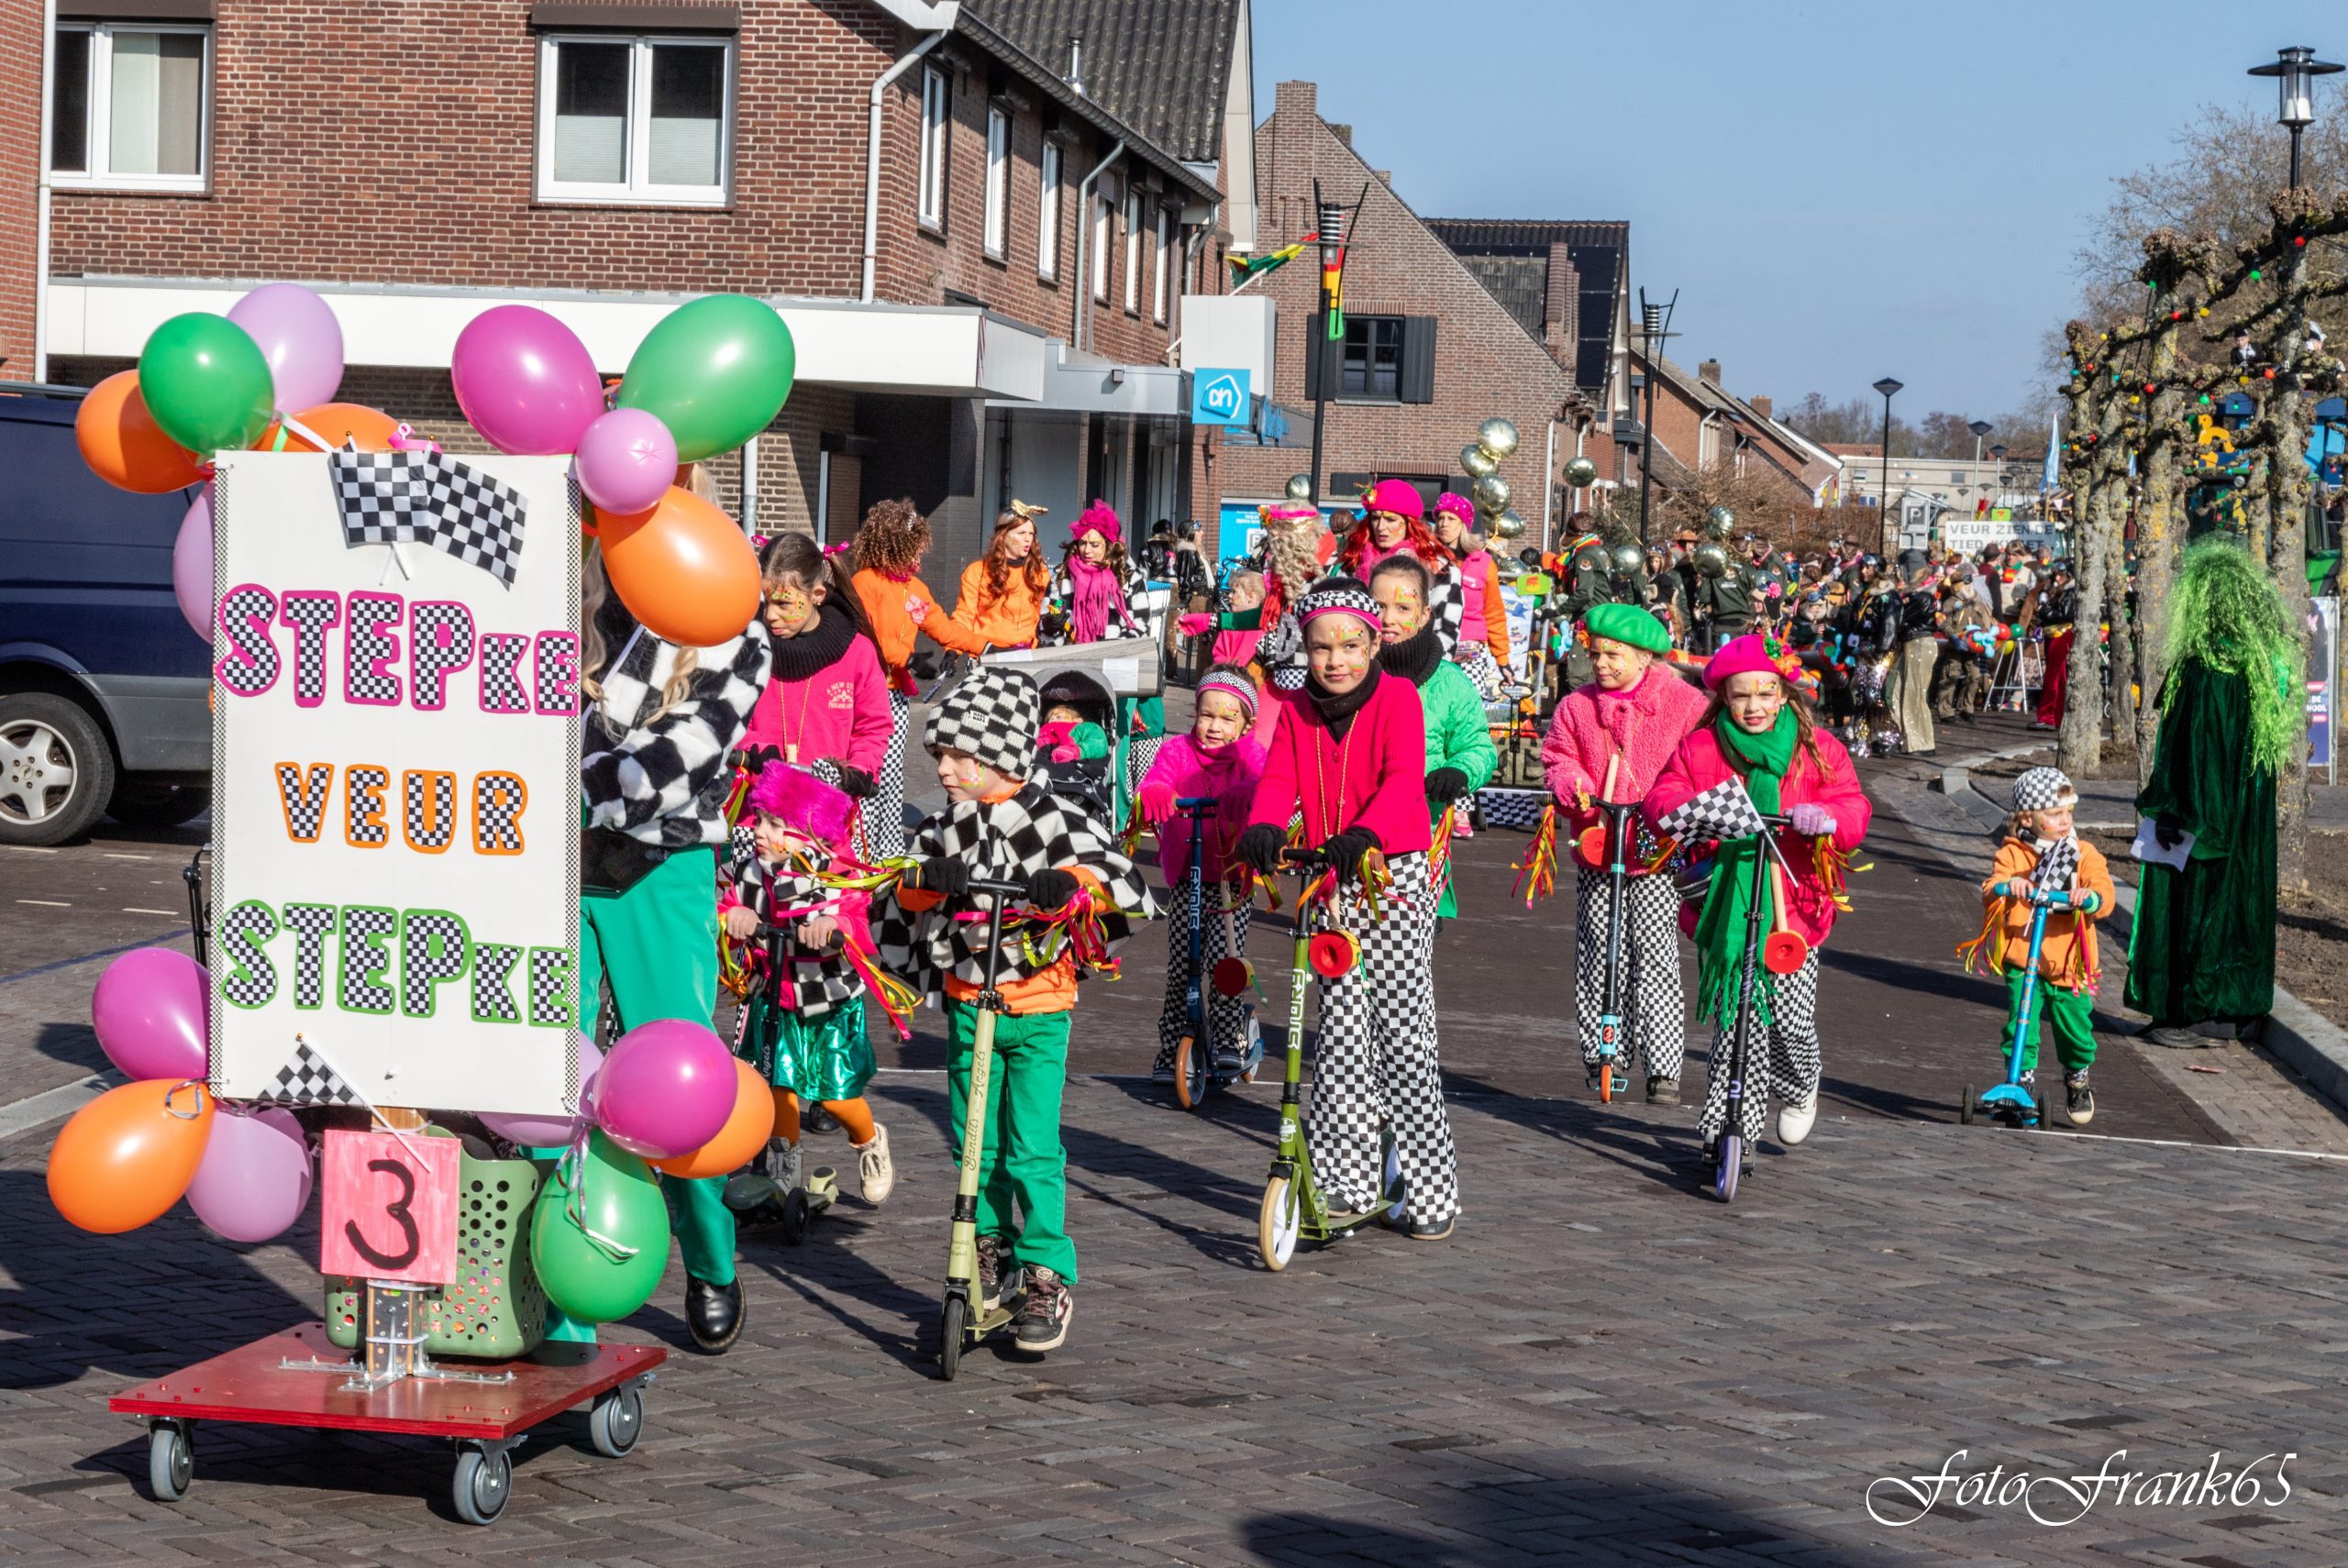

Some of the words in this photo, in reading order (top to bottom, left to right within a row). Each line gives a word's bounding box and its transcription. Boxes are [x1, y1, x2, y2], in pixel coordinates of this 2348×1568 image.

[1950, 525, 1989, 534] VEUR
[1996, 525, 2030, 535] ZIEN
[2035, 525, 2054, 535] DE
[1950, 539, 1983, 549] TIED
[1526, 576, 1541, 593] 5
[216, 583, 580, 716] STEPKE
[274, 762, 529, 856] VEUR
[217, 899, 576, 1029] STEPKE
[964, 1118, 979, 1171] Bandits
[972, 1050, 986, 1099] Angels
[345, 1159, 420, 1270] 3
